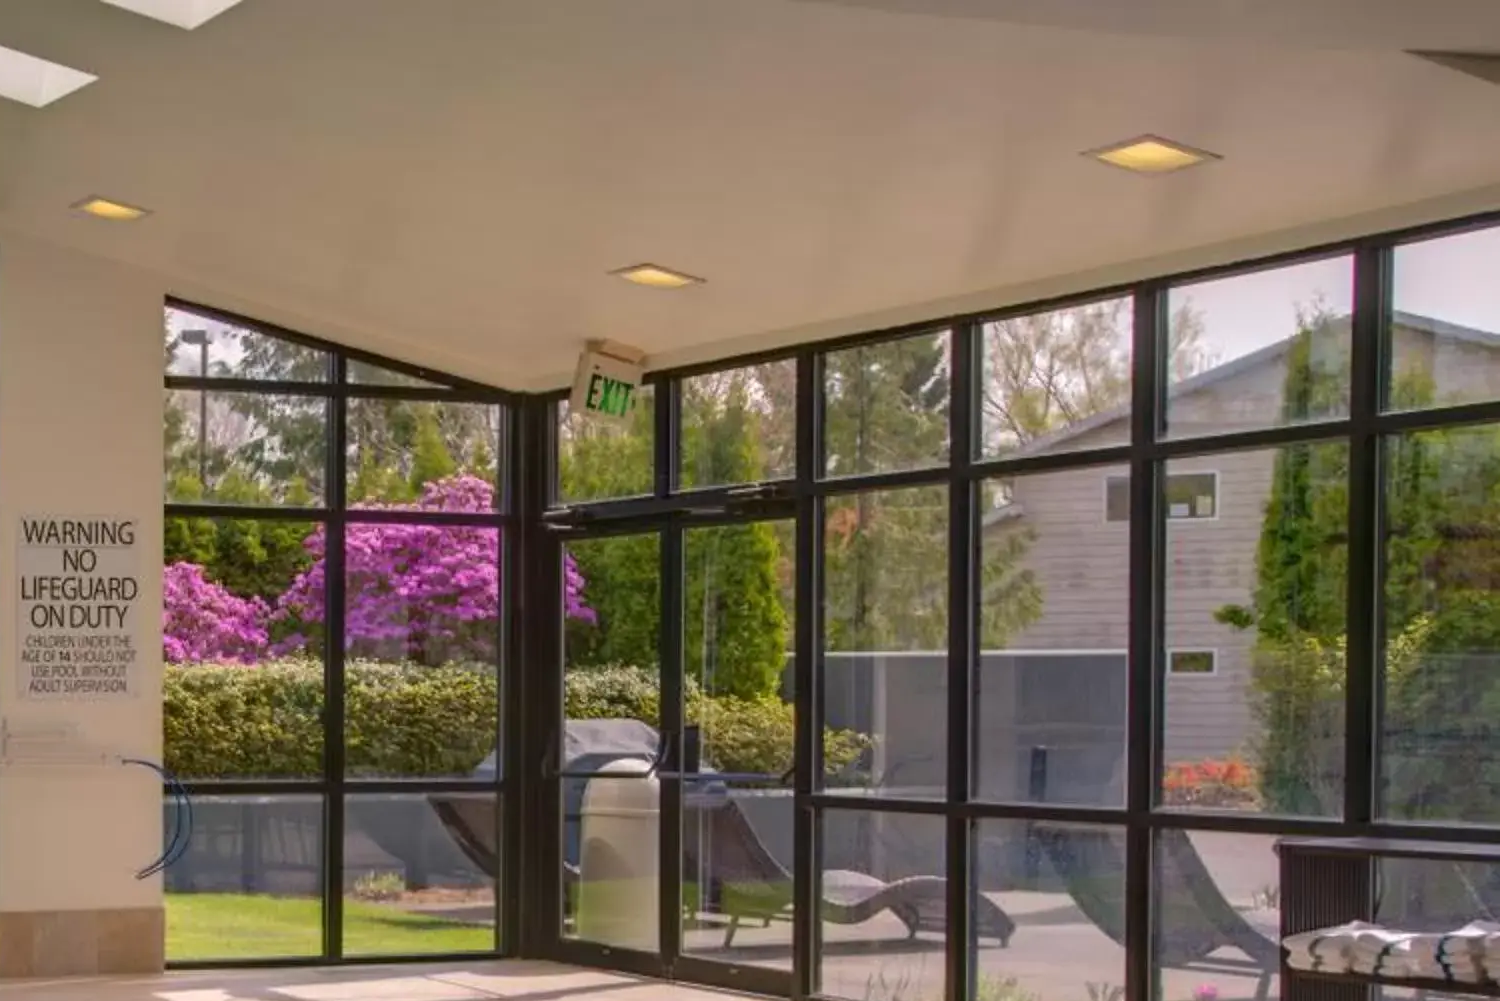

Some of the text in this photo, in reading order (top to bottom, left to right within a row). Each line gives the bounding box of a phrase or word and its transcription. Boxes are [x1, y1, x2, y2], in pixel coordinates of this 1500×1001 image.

[586, 374, 635, 417] EXIT
[23, 520, 135, 545] WARNING
[63, 549, 97, 572] NO
[21, 576, 138, 600] LIFEGUARD
[31, 604, 129, 628] ON DUTY
[25, 635, 75, 648] CHILDREN
[77, 635, 112, 648] UNDER
[21, 650, 40, 662] AGE
[43, 650, 56, 662] OF
[74, 650, 114, 662] SHOULD
[116, 650, 137, 662] NOT
[31, 665, 127, 677] USE POOL WITHOUT
[29, 680, 128, 692] ADULT SUPERVISION
